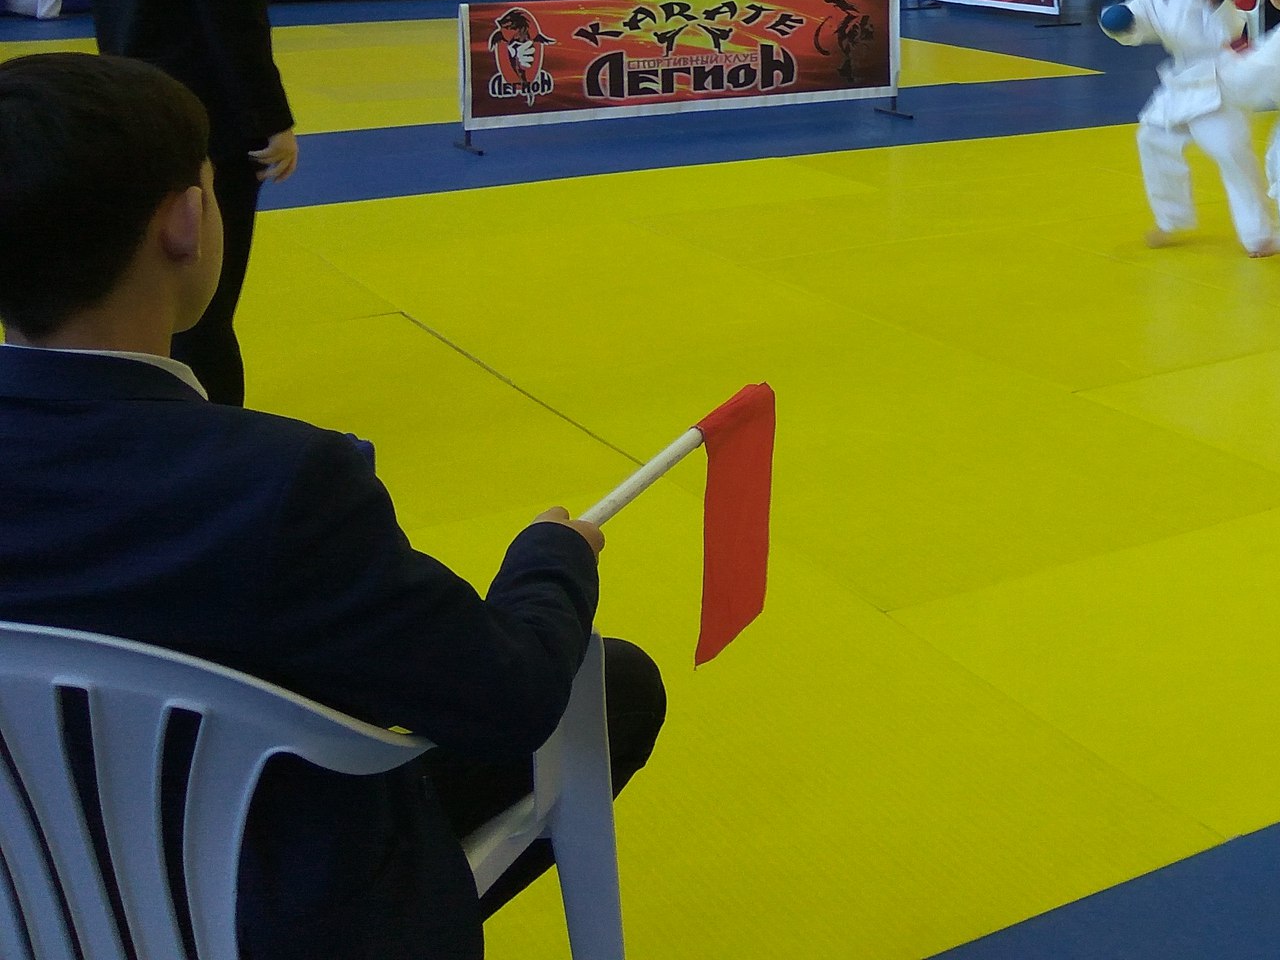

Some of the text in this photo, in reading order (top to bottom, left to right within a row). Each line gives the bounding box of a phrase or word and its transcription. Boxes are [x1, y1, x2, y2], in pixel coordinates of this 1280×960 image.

[573, 0, 805, 48] KARATE
[627, 52, 759, 70] СПОРТИВНЫЙ КЛУБ
